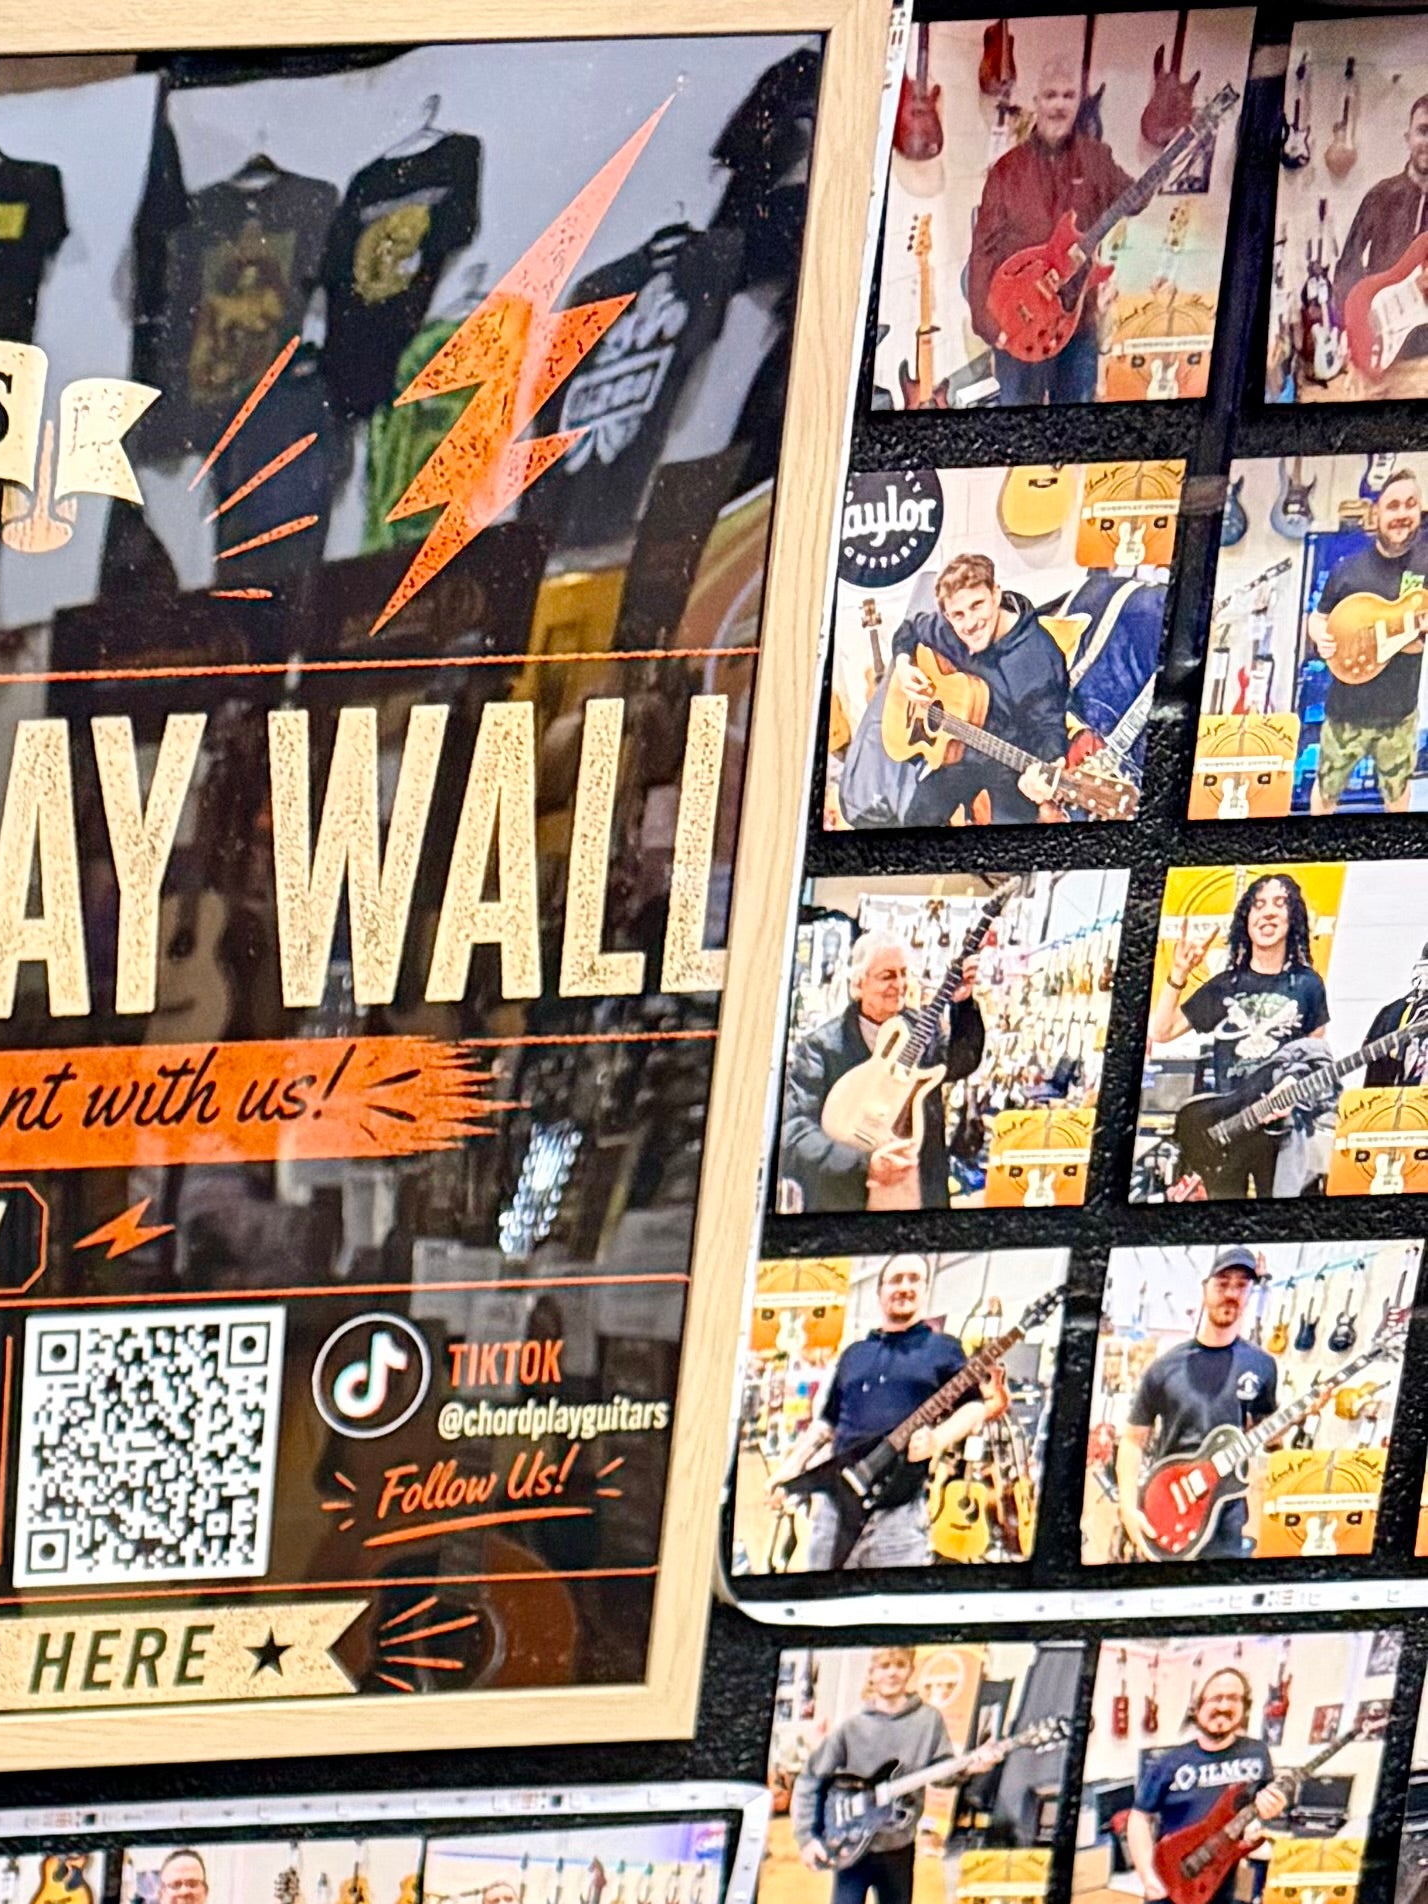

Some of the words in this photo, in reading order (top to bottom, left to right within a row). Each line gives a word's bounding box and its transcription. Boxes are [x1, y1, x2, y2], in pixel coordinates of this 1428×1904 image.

[842, 484, 938, 548] aylor
[267, 694, 730, 1008] WALL
[82, 1044, 221, 1128] with
[236, 1042, 357, 1124] us!
[448, 1338, 565, 1388] TIKTOK
[437, 1394, 670, 1442] @chordplayguitars
[376, 1457, 499, 1520] Follow
[506, 1442, 582, 1500] Us!
[27, 1623, 218, 1696] HERE
